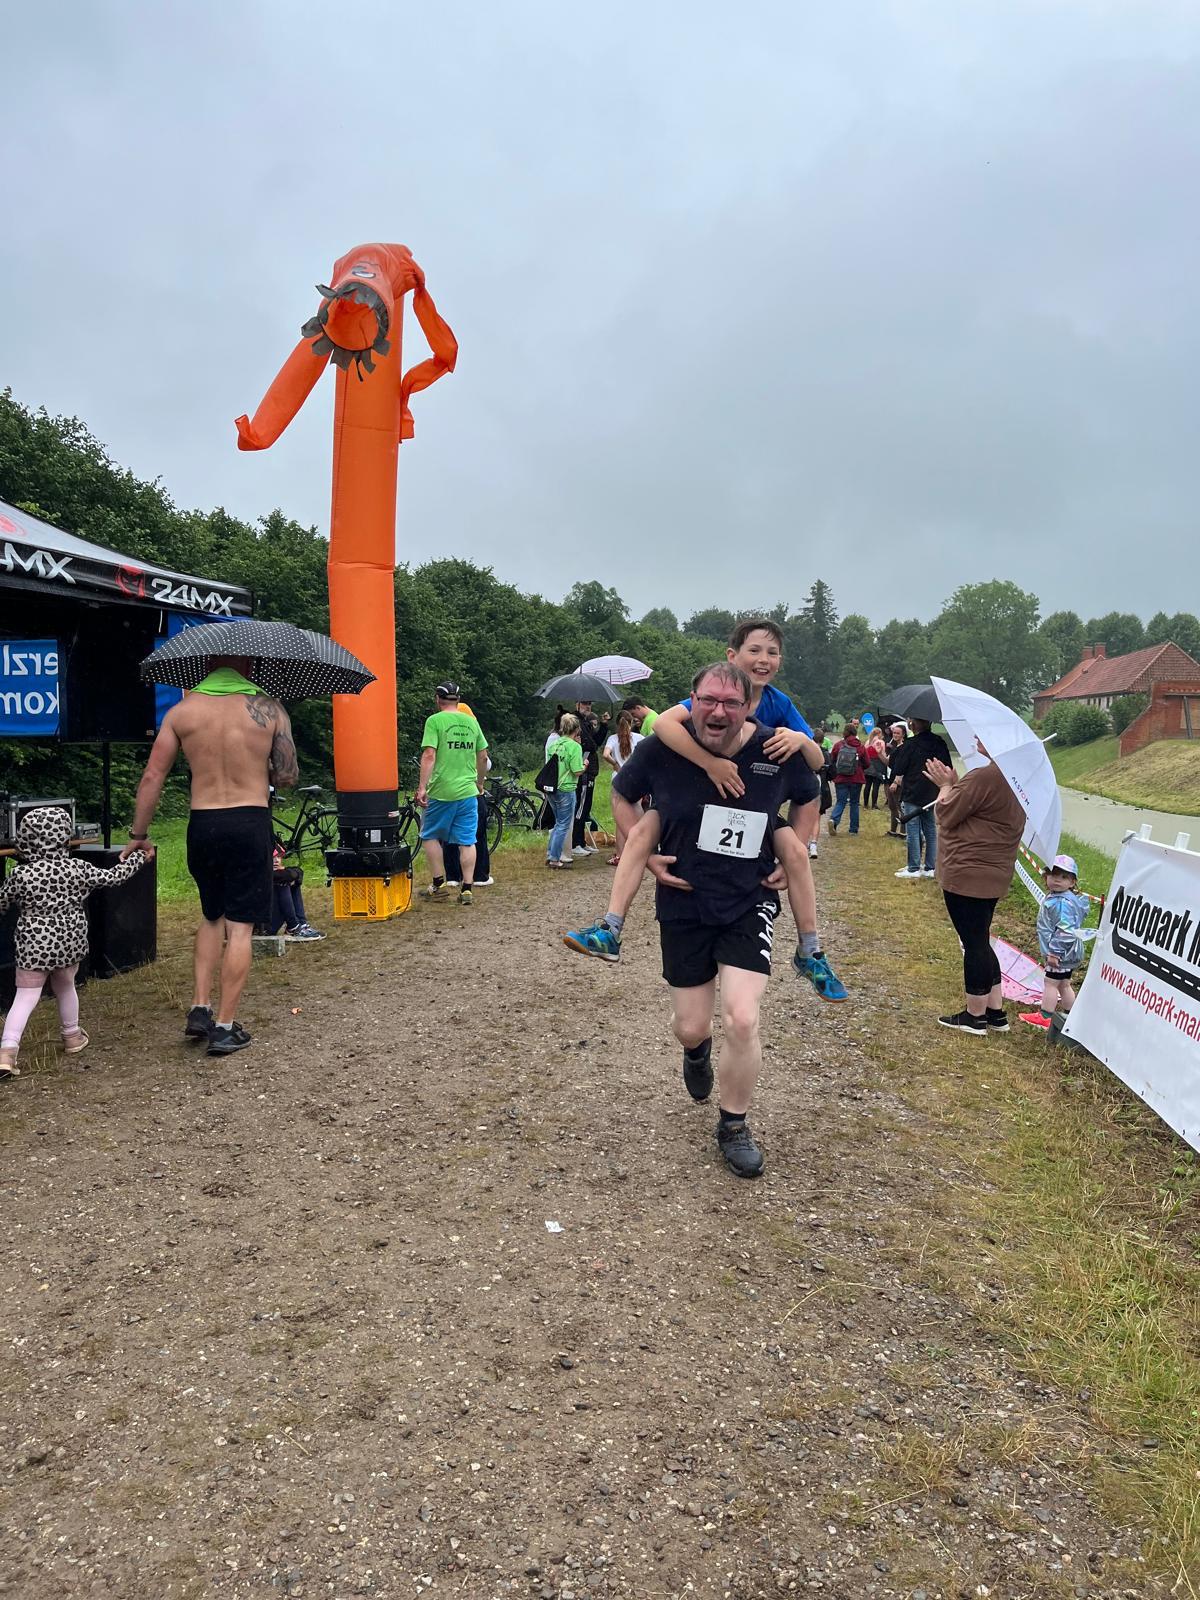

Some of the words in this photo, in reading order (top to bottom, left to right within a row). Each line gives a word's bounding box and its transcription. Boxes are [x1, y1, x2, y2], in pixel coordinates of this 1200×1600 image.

[0, 542, 76, 584] MX
[152, 578, 234, 617] 24MX
[447, 741, 474, 750] TEAM
[1012, 776, 1030, 806] ALSTOM
[719, 828, 744, 849] 21
[1110, 885, 1193, 958] Autopark
